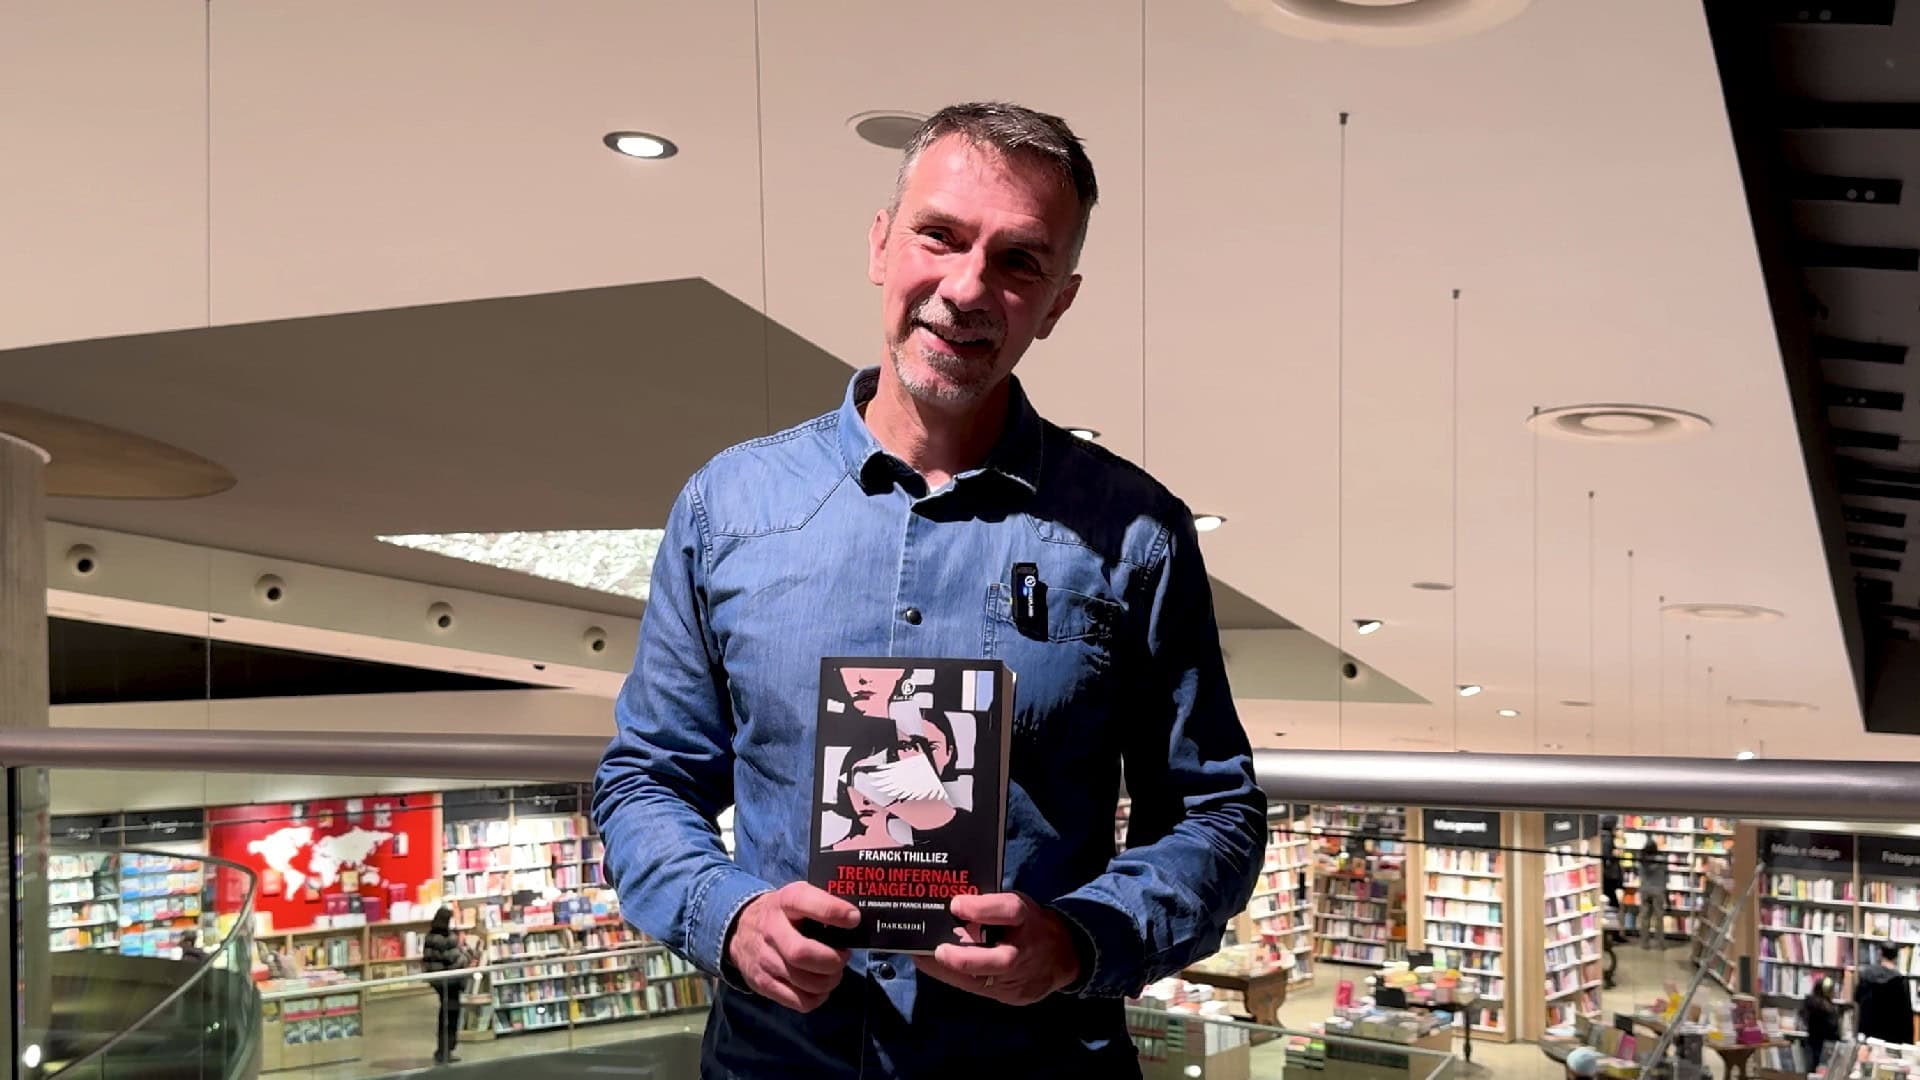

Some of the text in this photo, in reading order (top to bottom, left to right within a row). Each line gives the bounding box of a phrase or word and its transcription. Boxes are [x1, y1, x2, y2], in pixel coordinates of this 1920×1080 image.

[858, 850, 949, 864] FRANCK THILLIEZ
[837, 866, 969, 884] TRENO INFERNALE
[827, 880, 979, 898] PER L'ANGELO ROSSO
